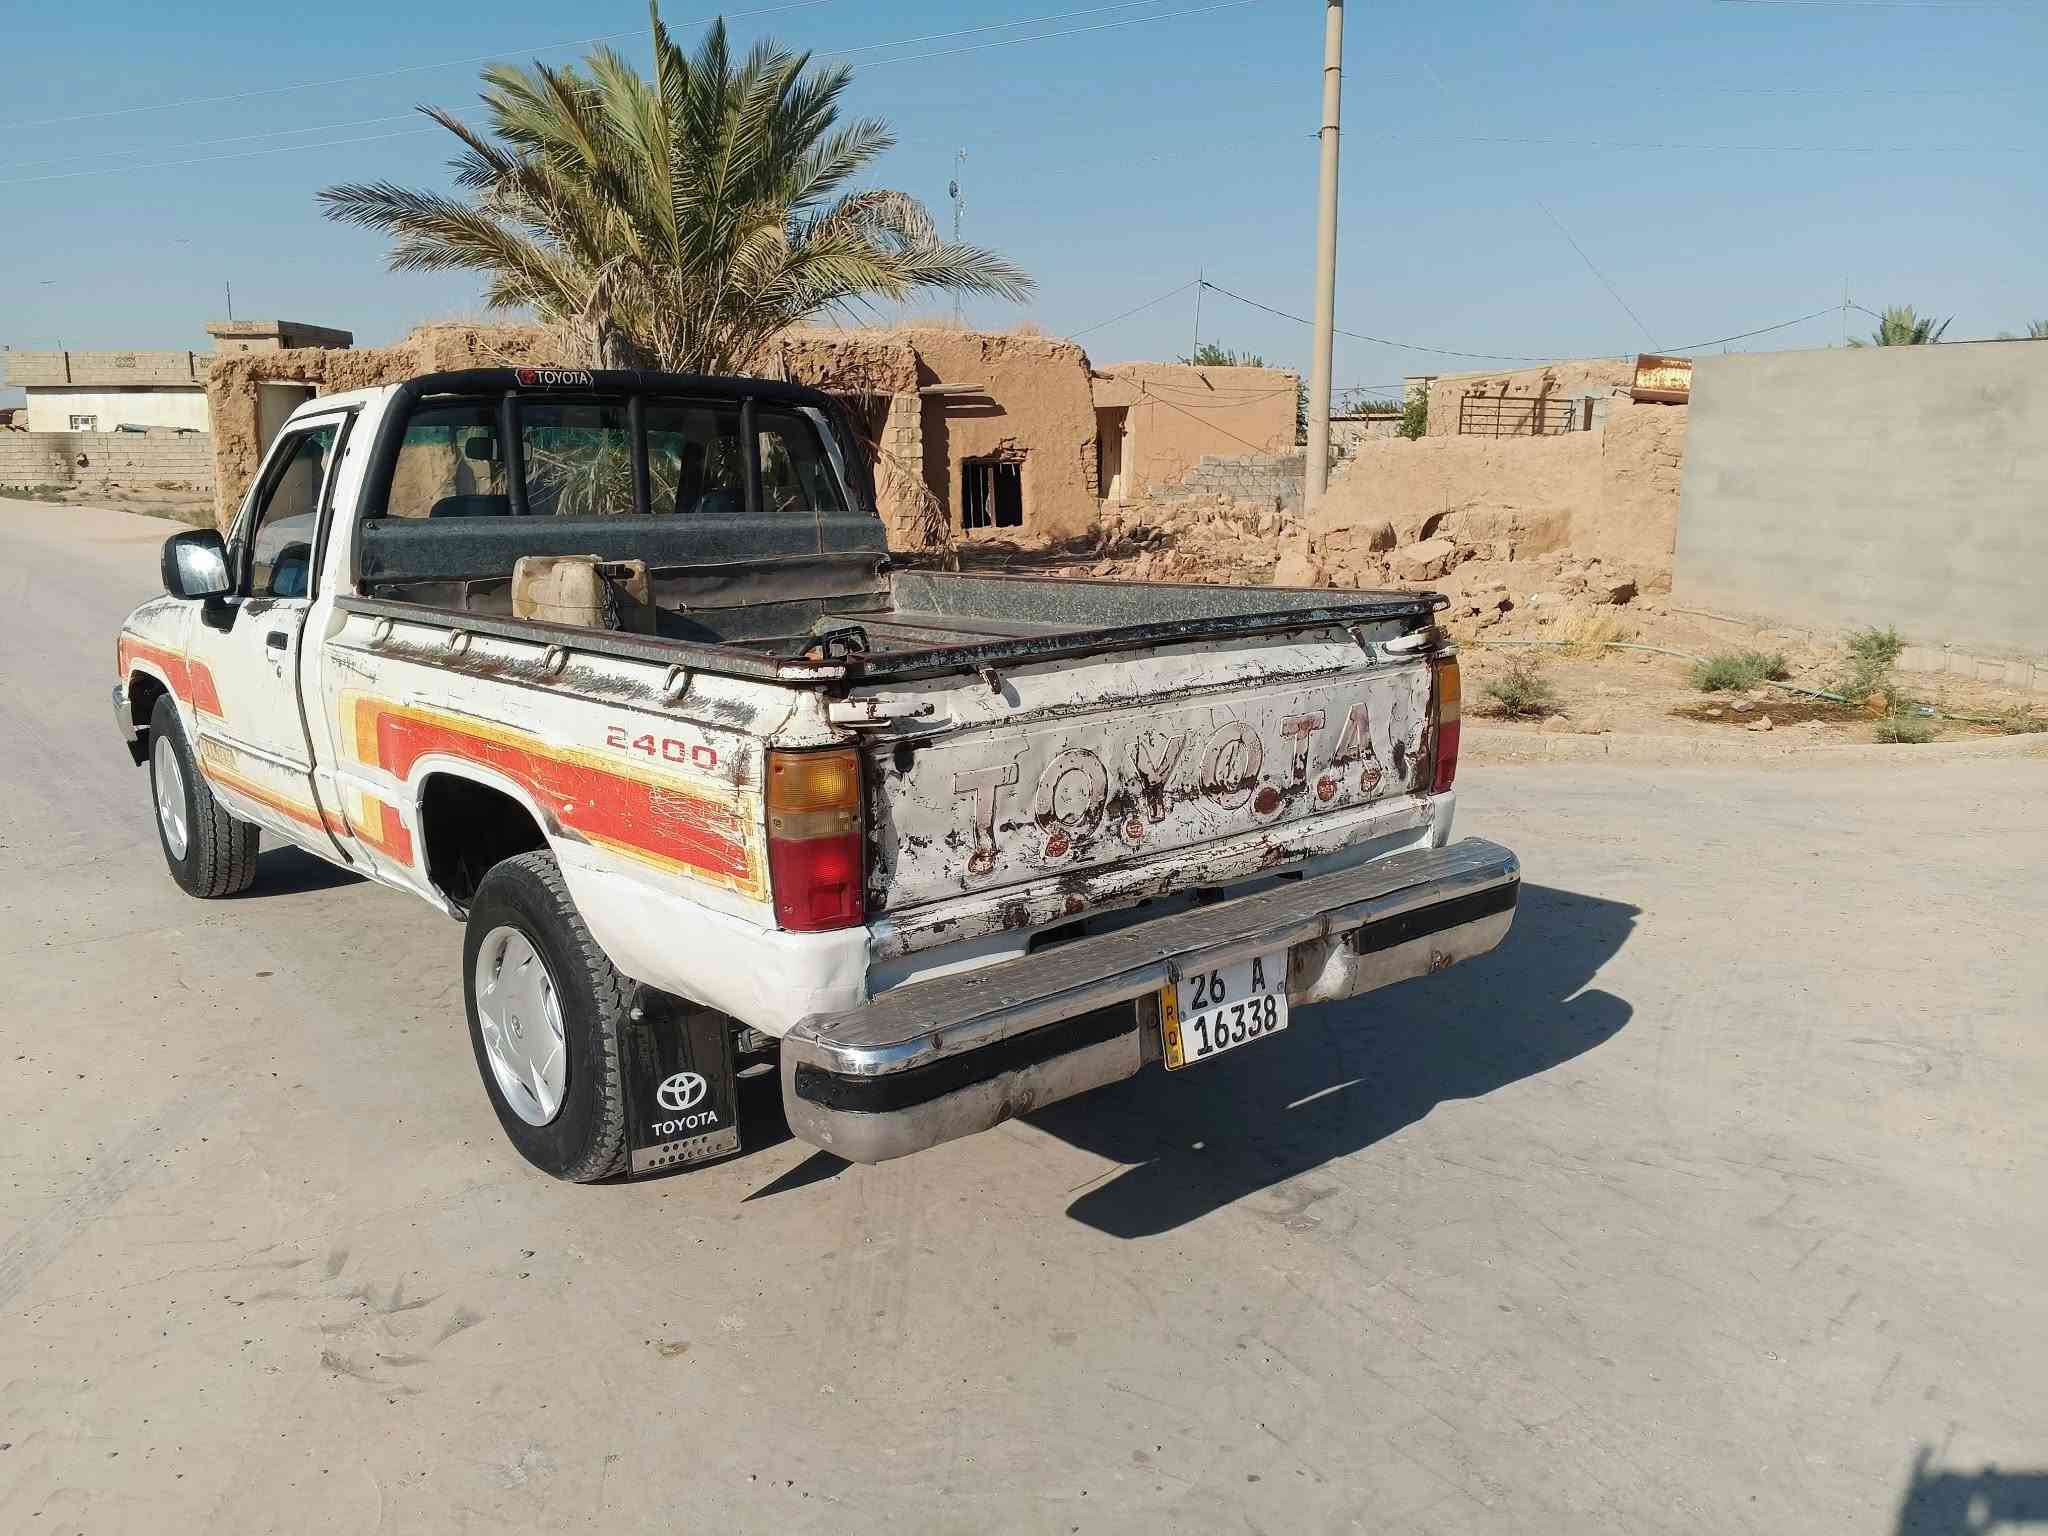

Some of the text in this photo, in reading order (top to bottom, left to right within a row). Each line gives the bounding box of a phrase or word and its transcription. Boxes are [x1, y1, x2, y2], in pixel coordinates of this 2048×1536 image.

[536, 370, 588, 385] TOYOTA
[606, 725, 718, 771] 2400
[952, 702, 1383, 872] TOYOTA
[1190, 957, 1266, 1011] 26 A
[1194, 994, 1278, 1057] 16338
[651, 1110, 719, 1137] TOYOTA
